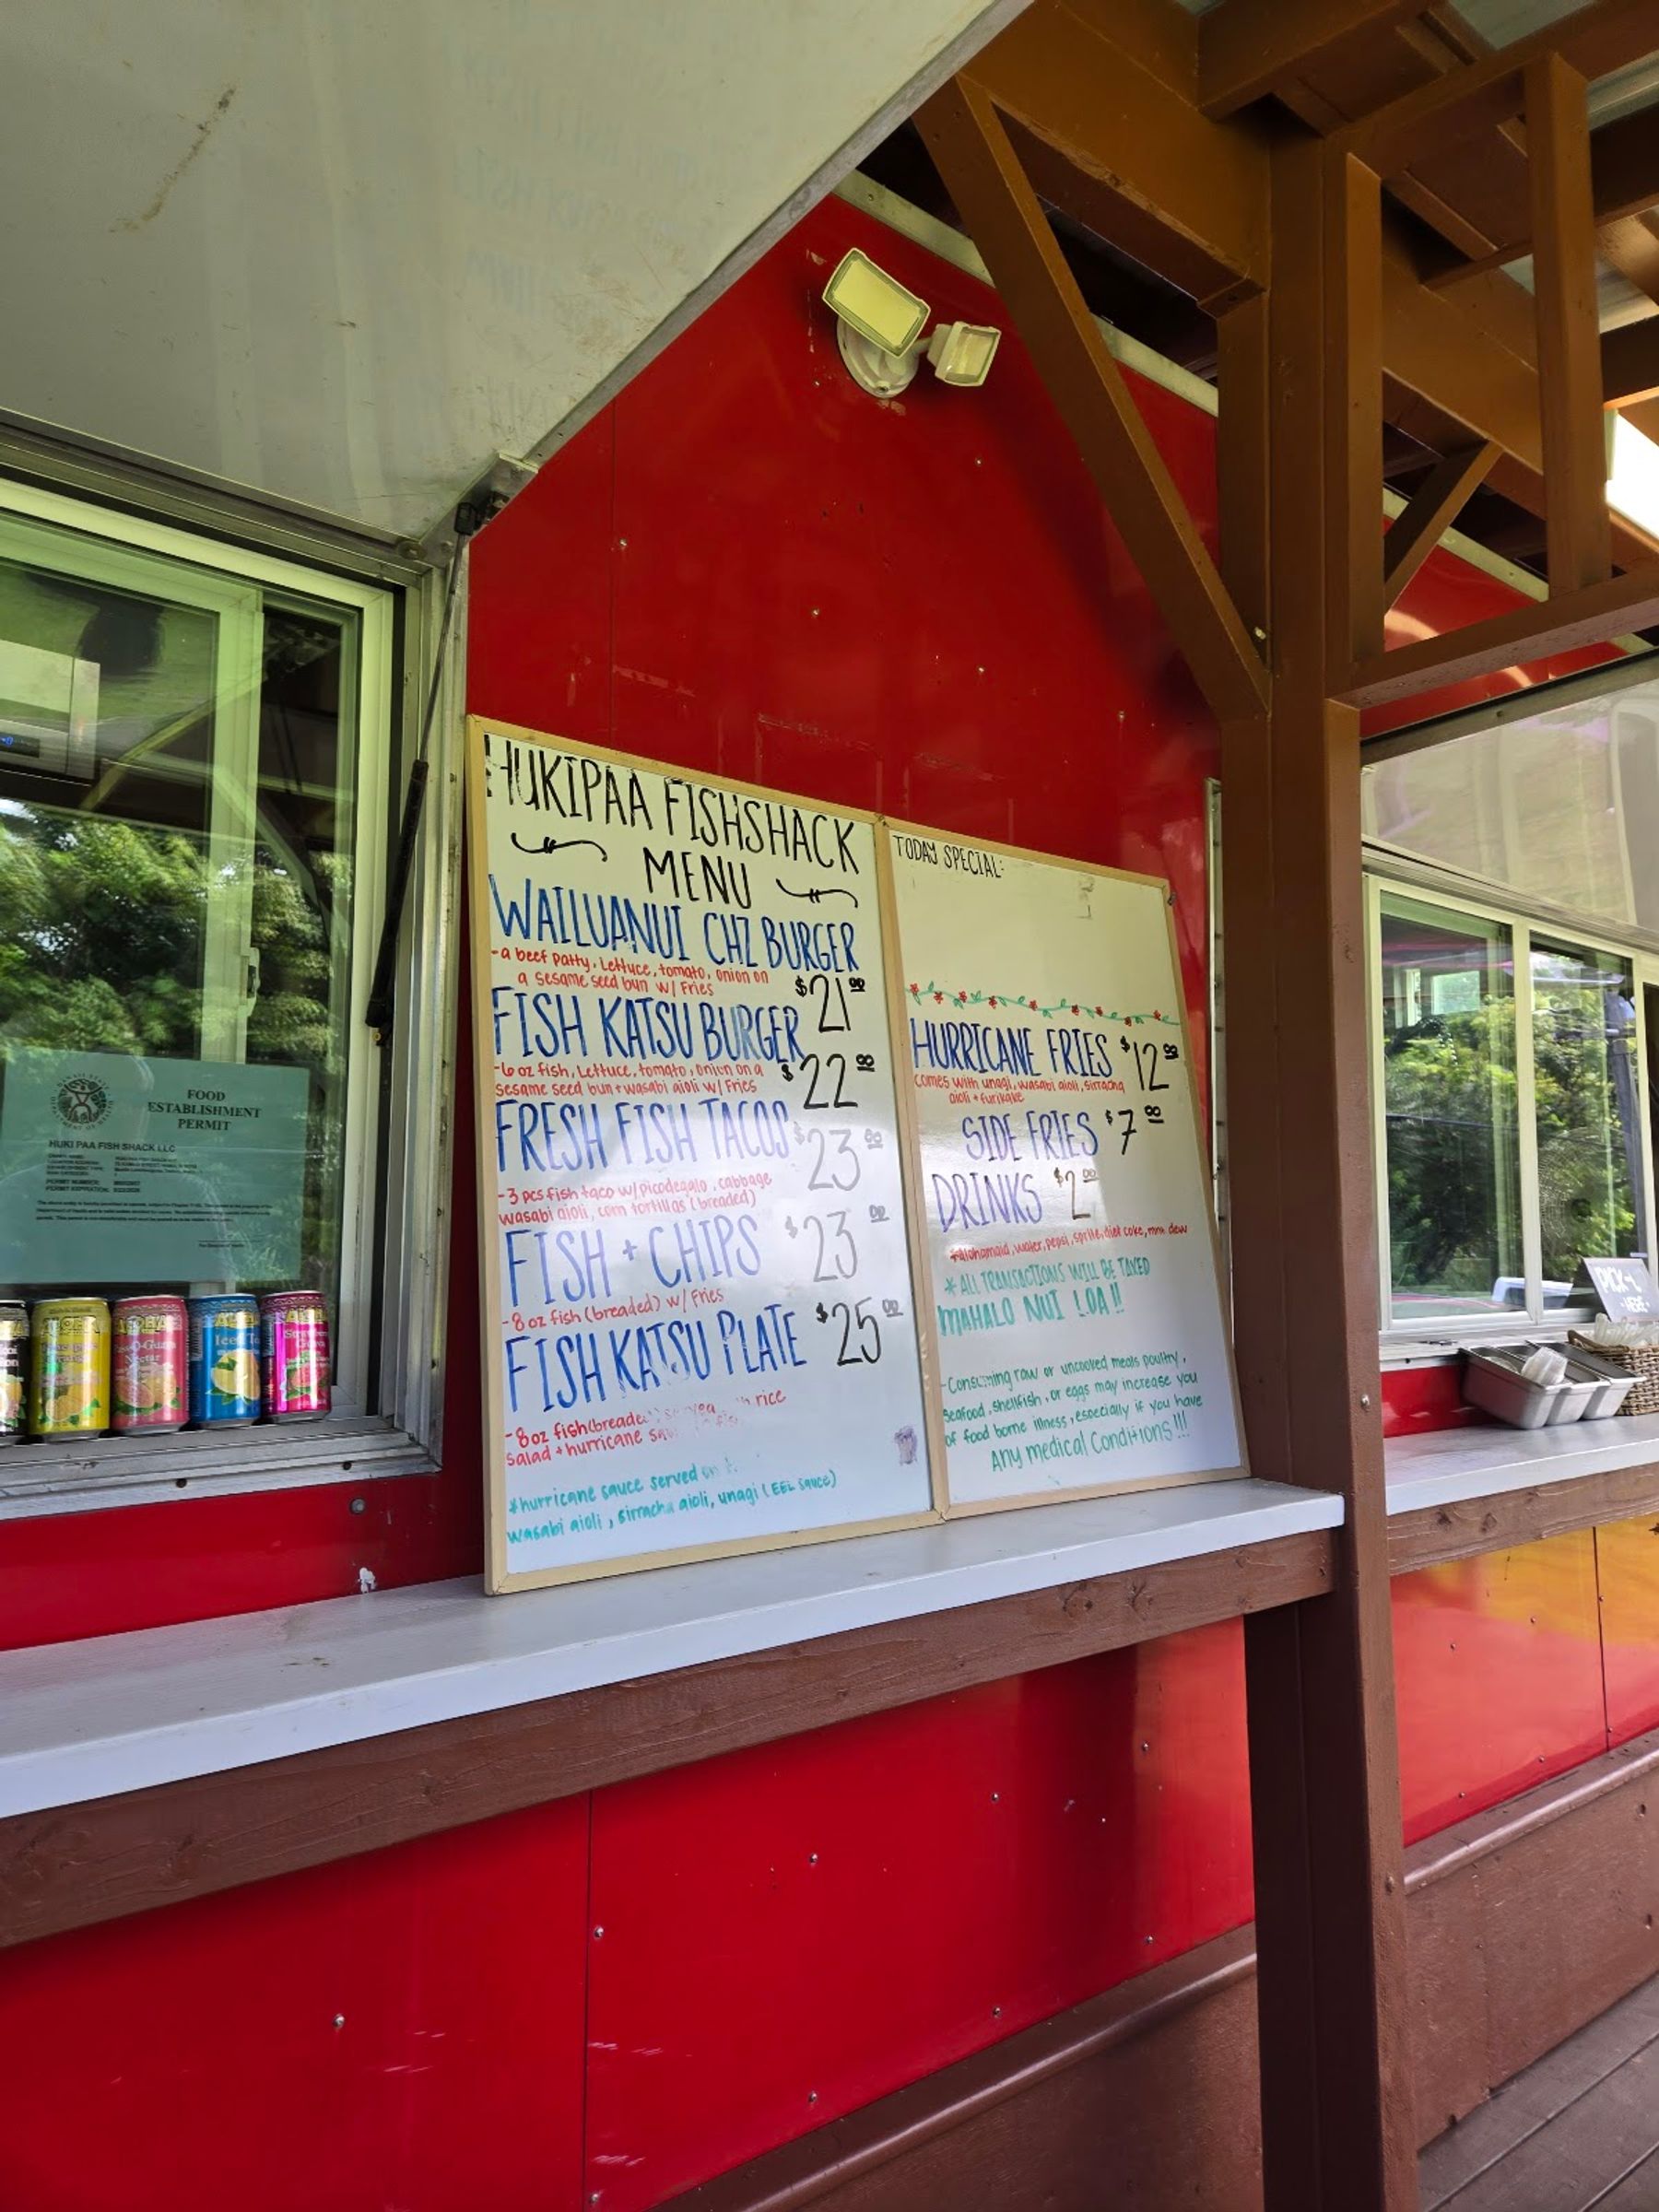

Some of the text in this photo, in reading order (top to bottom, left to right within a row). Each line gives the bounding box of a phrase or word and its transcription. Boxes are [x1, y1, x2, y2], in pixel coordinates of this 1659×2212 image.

[893, 835, 1005, 878] TODAY SPECIAL:
[643, 847, 752, 910] MENU
[488, 874, 860, 972] WAILUANUI CHZ BURGER
[516, 947, 547, 963] beef
[716, 968, 749, 984] onion
[753, 970, 770, 984] on
[518, 972, 528, 987] a
[535, 971, 589, 989] sesame
[591, 972, 619, 990] seed
[622, 973, 649, 994] bun
[681, 982, 715, 997] Fries
[492, 986, 806, 1064] FISH KATSU BURGER
[910, 1018, 1041, 1077] HURRICANE
[1047, 1029, 1112, 1077] FRIES
[496, 1081, 547, 1097] sesame
[552, 1081, 582, 1096] seed
[588, 1082, 612, 1095] bun
[624, 1079, 668, 1095] wasabi
[674, 1079, 700, 1094] aioli
[518, 1066, 535, 1077] oz
[696, 1063, 734, 1077] onion
[736, 1064, 749, 1077] on
[753, 1064, 764, 1077] a
[952, 1077, 979, 1089] with
[147, 1101, 263, 1118] ESTABLISHMENT
[187, 1088, 226, 1102] FOOD
[178, 1118, 233, 1132] PERMIT
[497, 1098, 791, 1172] FRESH FISH TACOS
[961, 1112, 1022, 1162] SIDE
[1026, 1110, 1100, 1160] FRIES
[48, 1139, 176, 1153] HUKI PAA FISH SHACK LLC
[523, 1190, 544, 1204] pcs
[547, 1186, 579, 1201] fish
[582, 1185, 614, 1200] taco
[719, 1171, 773, 1191] cabbage
[932, 1171, 1043, 1233] DRINKS
[499, 1206, 554, 1225] wasabi
[631, 1199, 687, 1215] tortillas
[505, 1229, 612, 1308] FISH
[648, 1214, 761, 1288] CHIPS
[1067, 1261, 1100, 1283] WILL
[1100, 1257, 1117, 1280] BE
[1117, 1256, 1151, 1277] TAXED
[528, 1316, 547, 1330] oz
[550, 1309, 582, 1326] fish
[690, 1288, 724, 1309] Fries
[1023, 1288, 1065, 1323] NUI
[505, 1303, 807, 1413] FISH KATSU PLATE
[1014, 1368, 1039, 1382] raw
[1043, 1366, 1054, 1378] or
[1050, 1389, 1061, 1402] or
[1065, 1383, 1090, 1402] eggs
[1095, 1378, 1119, 1396] may
[1122, 1373, 1172, 1391] increase
[532, 1430, 549, 1445] oz
[756, 1390, 786, 1406] rice
[945, 1430, 957, 1448] of
[963, 1423, 990, 1444] food
[1135, 1398, 1145, 1413] if
[1149, 1398, 1171, 1416] you
[1173, 1393, 1203, 1408] have
[505, 1444, 552, 1466] salad
[565, 1429, 643, 1457] hurricane
[991, 1430, 1089, 1472] Any medical
[600, 1477, 644, 1500] sauce
[650, 1463, 698, 1490] served
[506, 1518, 565, 1545] wasabi
[718, 1482, 759, 1507] unagi
